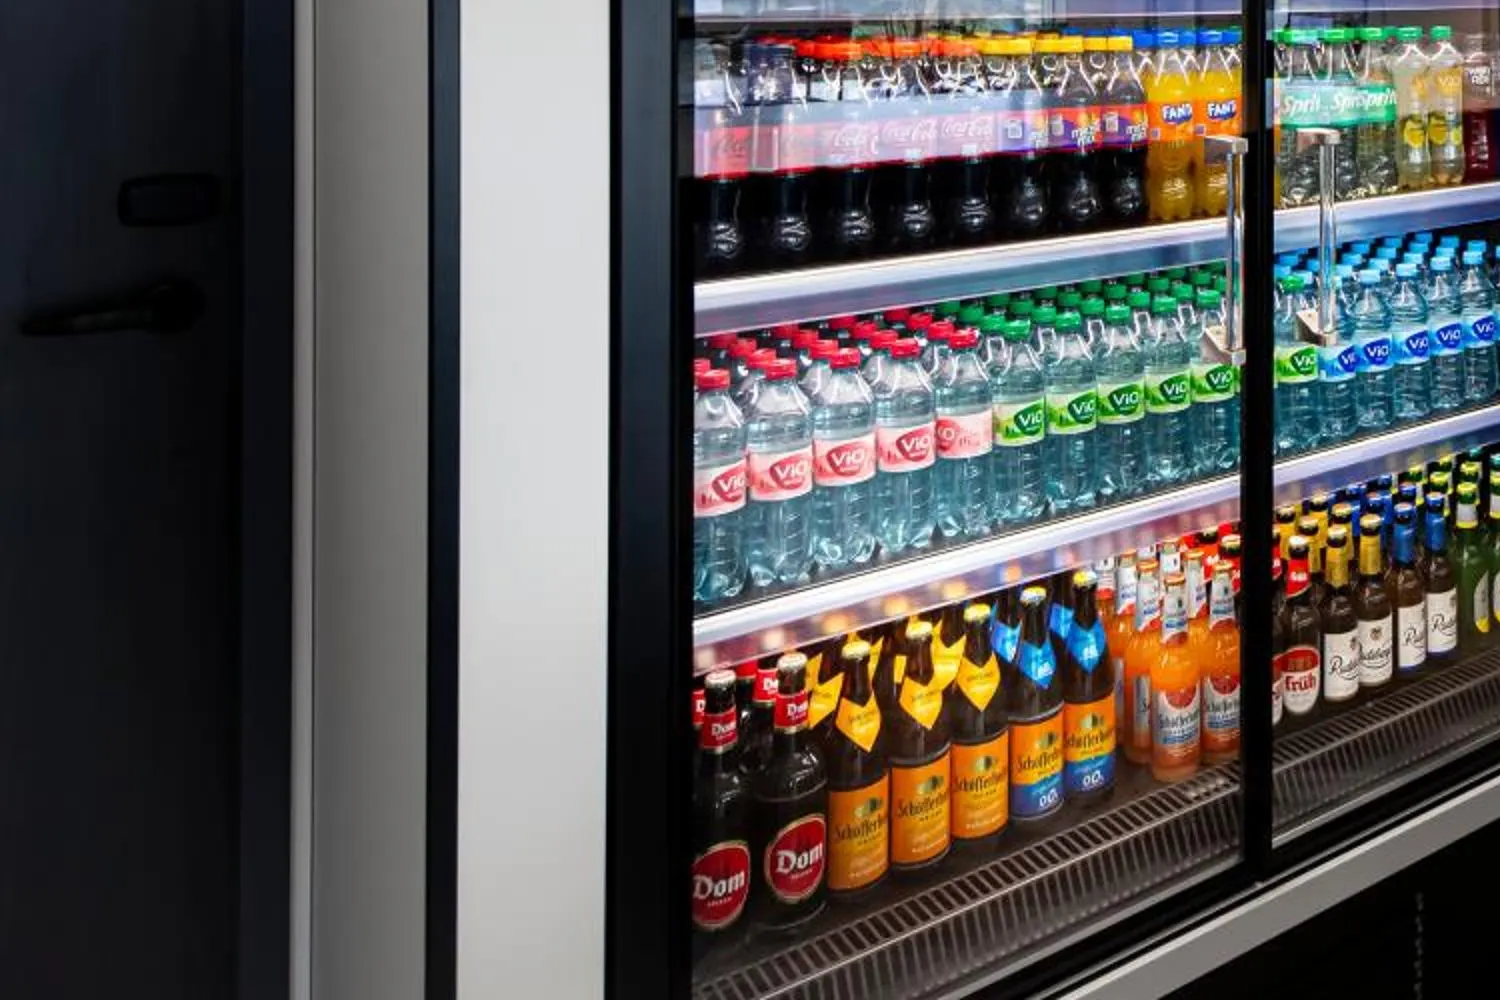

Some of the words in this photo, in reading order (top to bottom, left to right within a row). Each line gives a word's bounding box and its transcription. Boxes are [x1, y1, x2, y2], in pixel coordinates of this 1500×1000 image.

[1162, 103, 1192, 121] FANT
[1207, 100, 1236, 118] FANT
[776, 842, 822, 874] Dom
[694, 871, 744, 900] Dom
